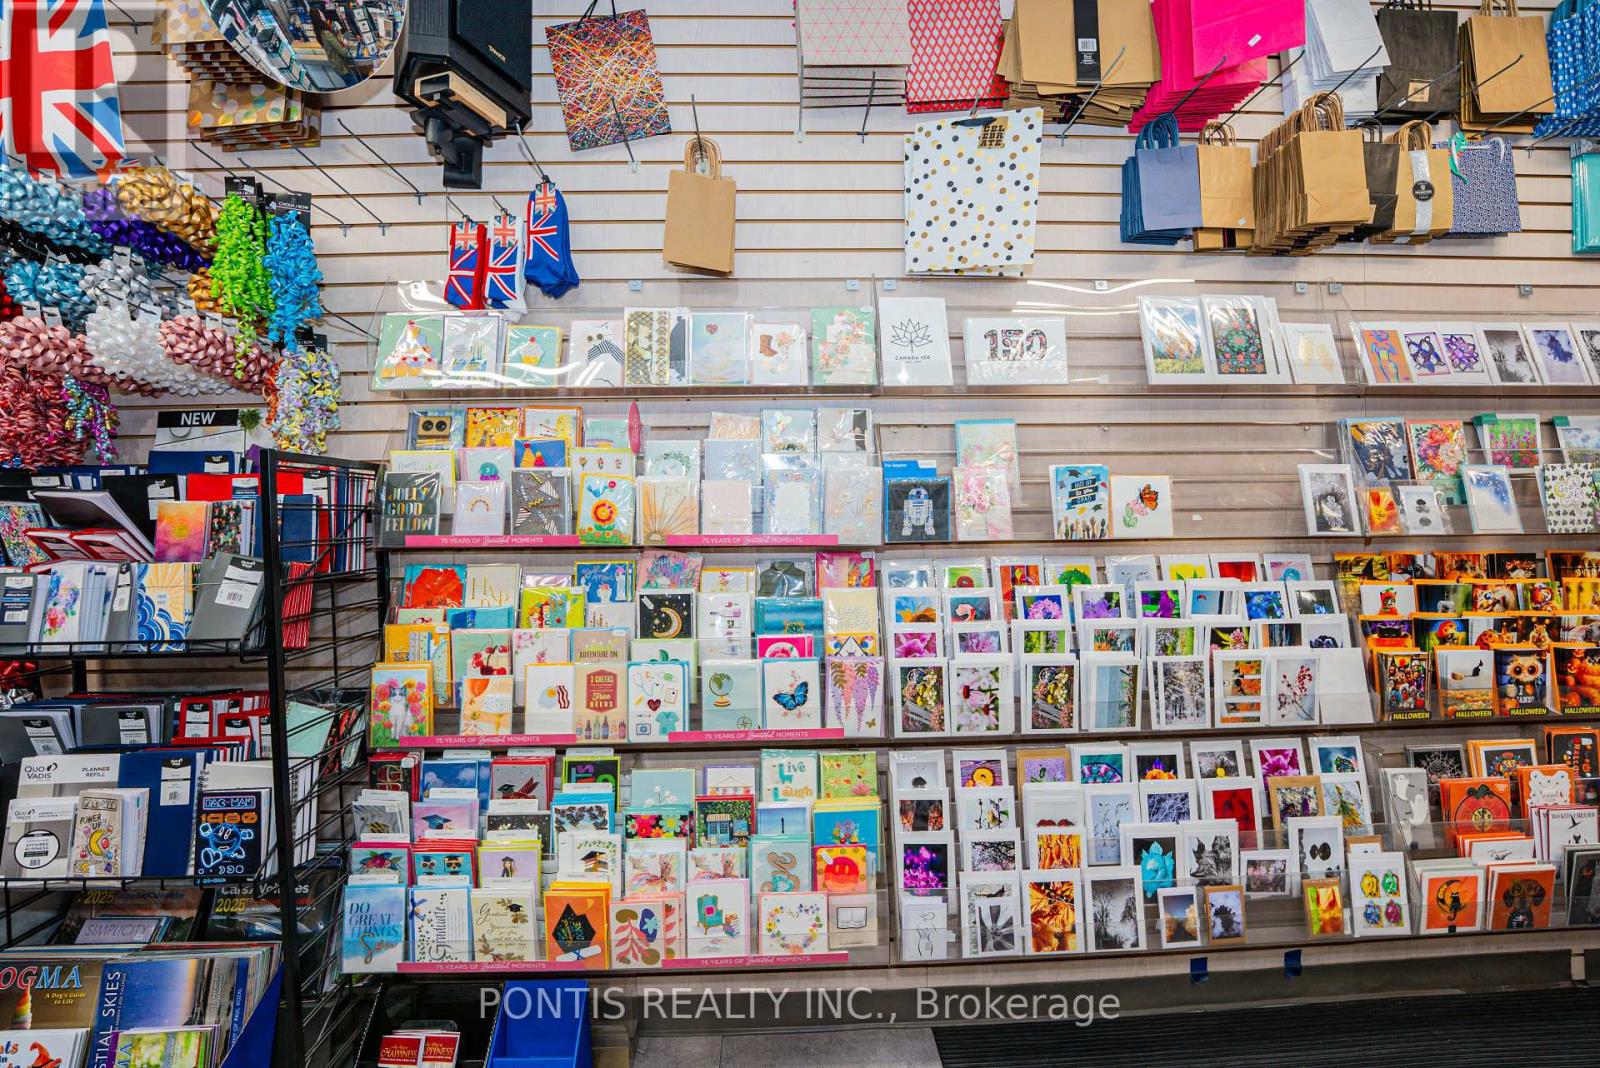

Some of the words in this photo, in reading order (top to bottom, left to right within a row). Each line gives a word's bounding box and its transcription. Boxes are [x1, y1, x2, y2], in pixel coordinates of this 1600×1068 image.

[180, 411, 216, 426] NEW
[1456, 710, 1492, 718] HALLOWEEN
[1510, 708, 1547, 716] HALLOWEEN
[24, 765, 45, 773] QUO
[26, 772, 52, 780] VADIS
[204, 797, 255, 809] PAC-MAN
[80, 814, 102, 825] POWER
[215, 897, 246, 912] 2025
[349, 902, 371, 914] DO
[349, 913, 393, 926] GREAT
[85, 923, 150, 937] SIMPLICITY
[352, 925, 401, 938] THINGS
[102, 971, 121, 1017] SKIES
[380, 1047, 418, 1058] HAPPINESS
